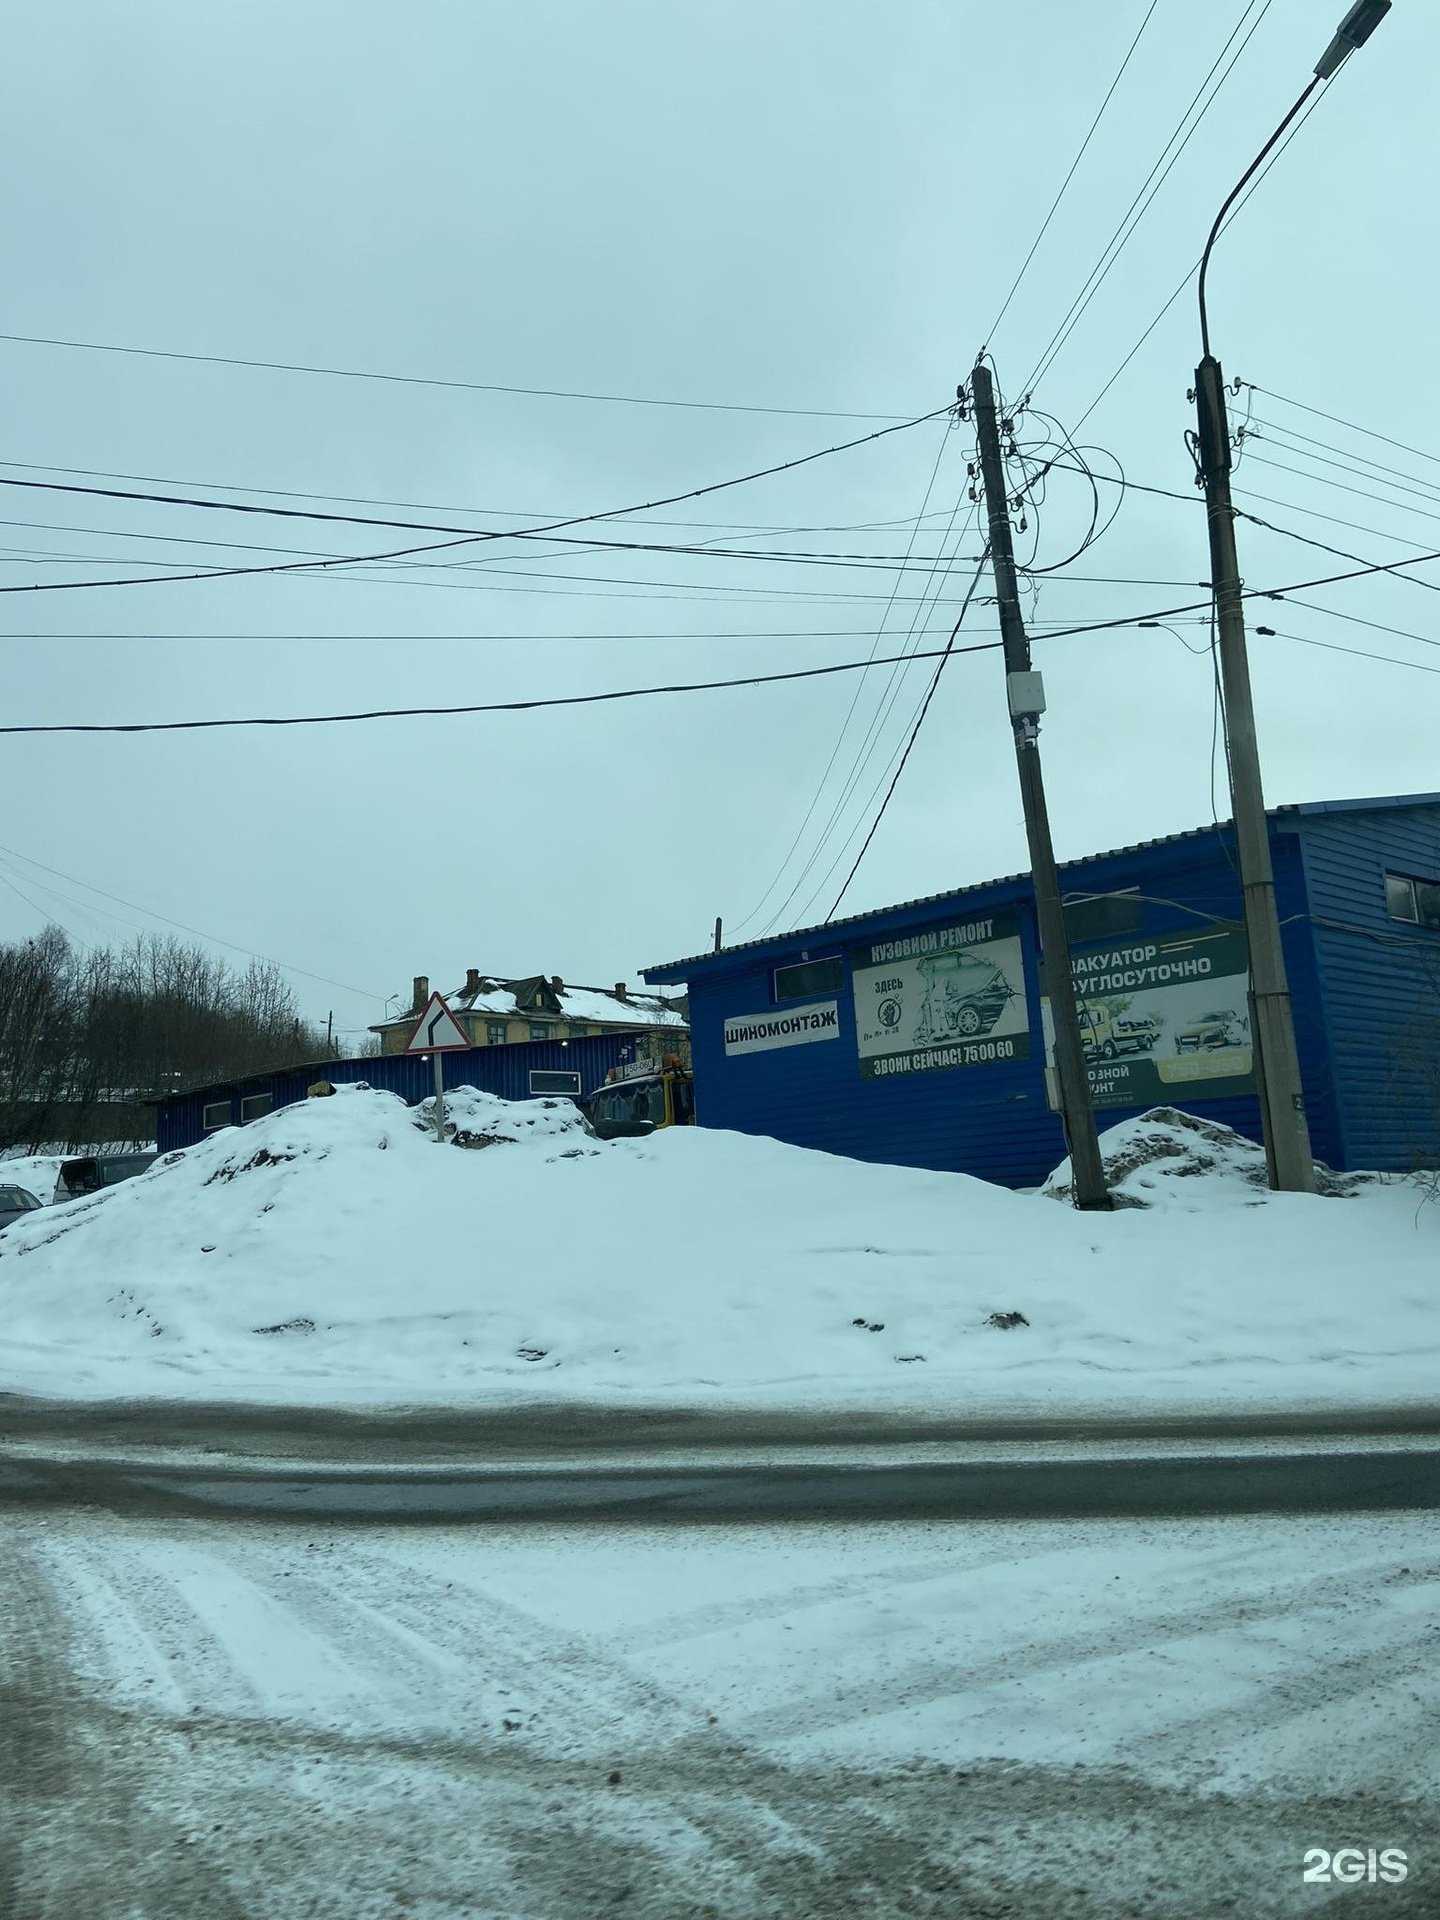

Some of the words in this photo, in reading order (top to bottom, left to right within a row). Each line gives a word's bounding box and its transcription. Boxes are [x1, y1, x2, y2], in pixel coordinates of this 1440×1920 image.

[871, 931, 937, 963] КУЗОВНОЙ
[939, 919, 993, 948] РЕМОНТ
[1071, 944, 1156, 974] АКУАТОР
[874, 978, 903, 994] ЗДЕСЬ
[1072, 957, 1211, 994] УГЛОСУТОЧНО
[874, 1056, 911, 1075] ЗВОНИ
[913, 1048, 962, 1070] СЕЙЧАС!
